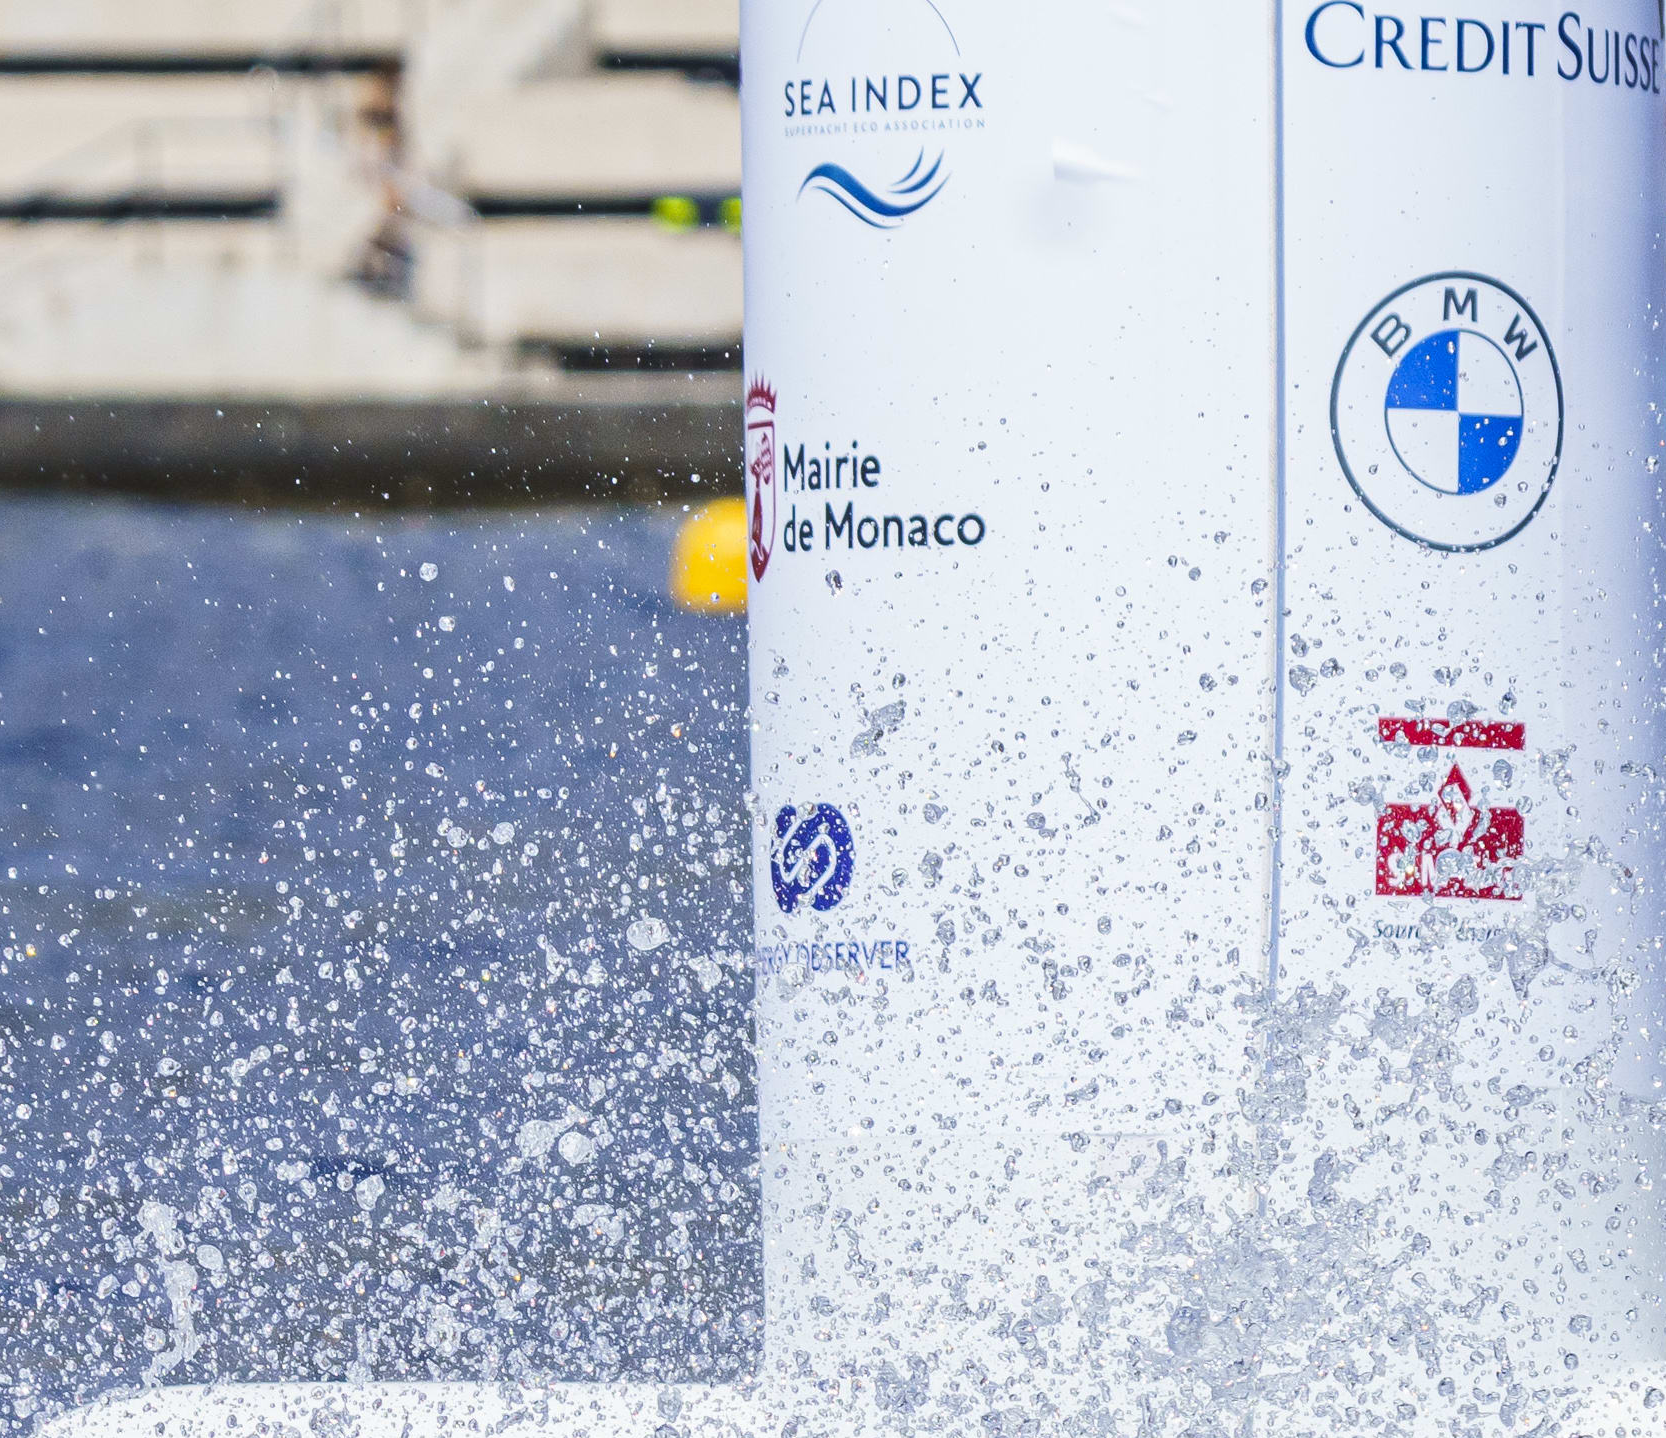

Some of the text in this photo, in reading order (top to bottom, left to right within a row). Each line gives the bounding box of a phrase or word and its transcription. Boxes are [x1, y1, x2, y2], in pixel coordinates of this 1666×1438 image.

[1305, 1, 1661, 95] CREDIT SUISSE
[784, 73, 983, 117] SEA INDEX
[784, 118, 986, 137] SUPERYACHT ECO ASSOCIATION
[1370, 287, 1538, 362] BMW
[784, 440, 881, 492] Mairie
[784, 501, 986, 552] de Monaco
